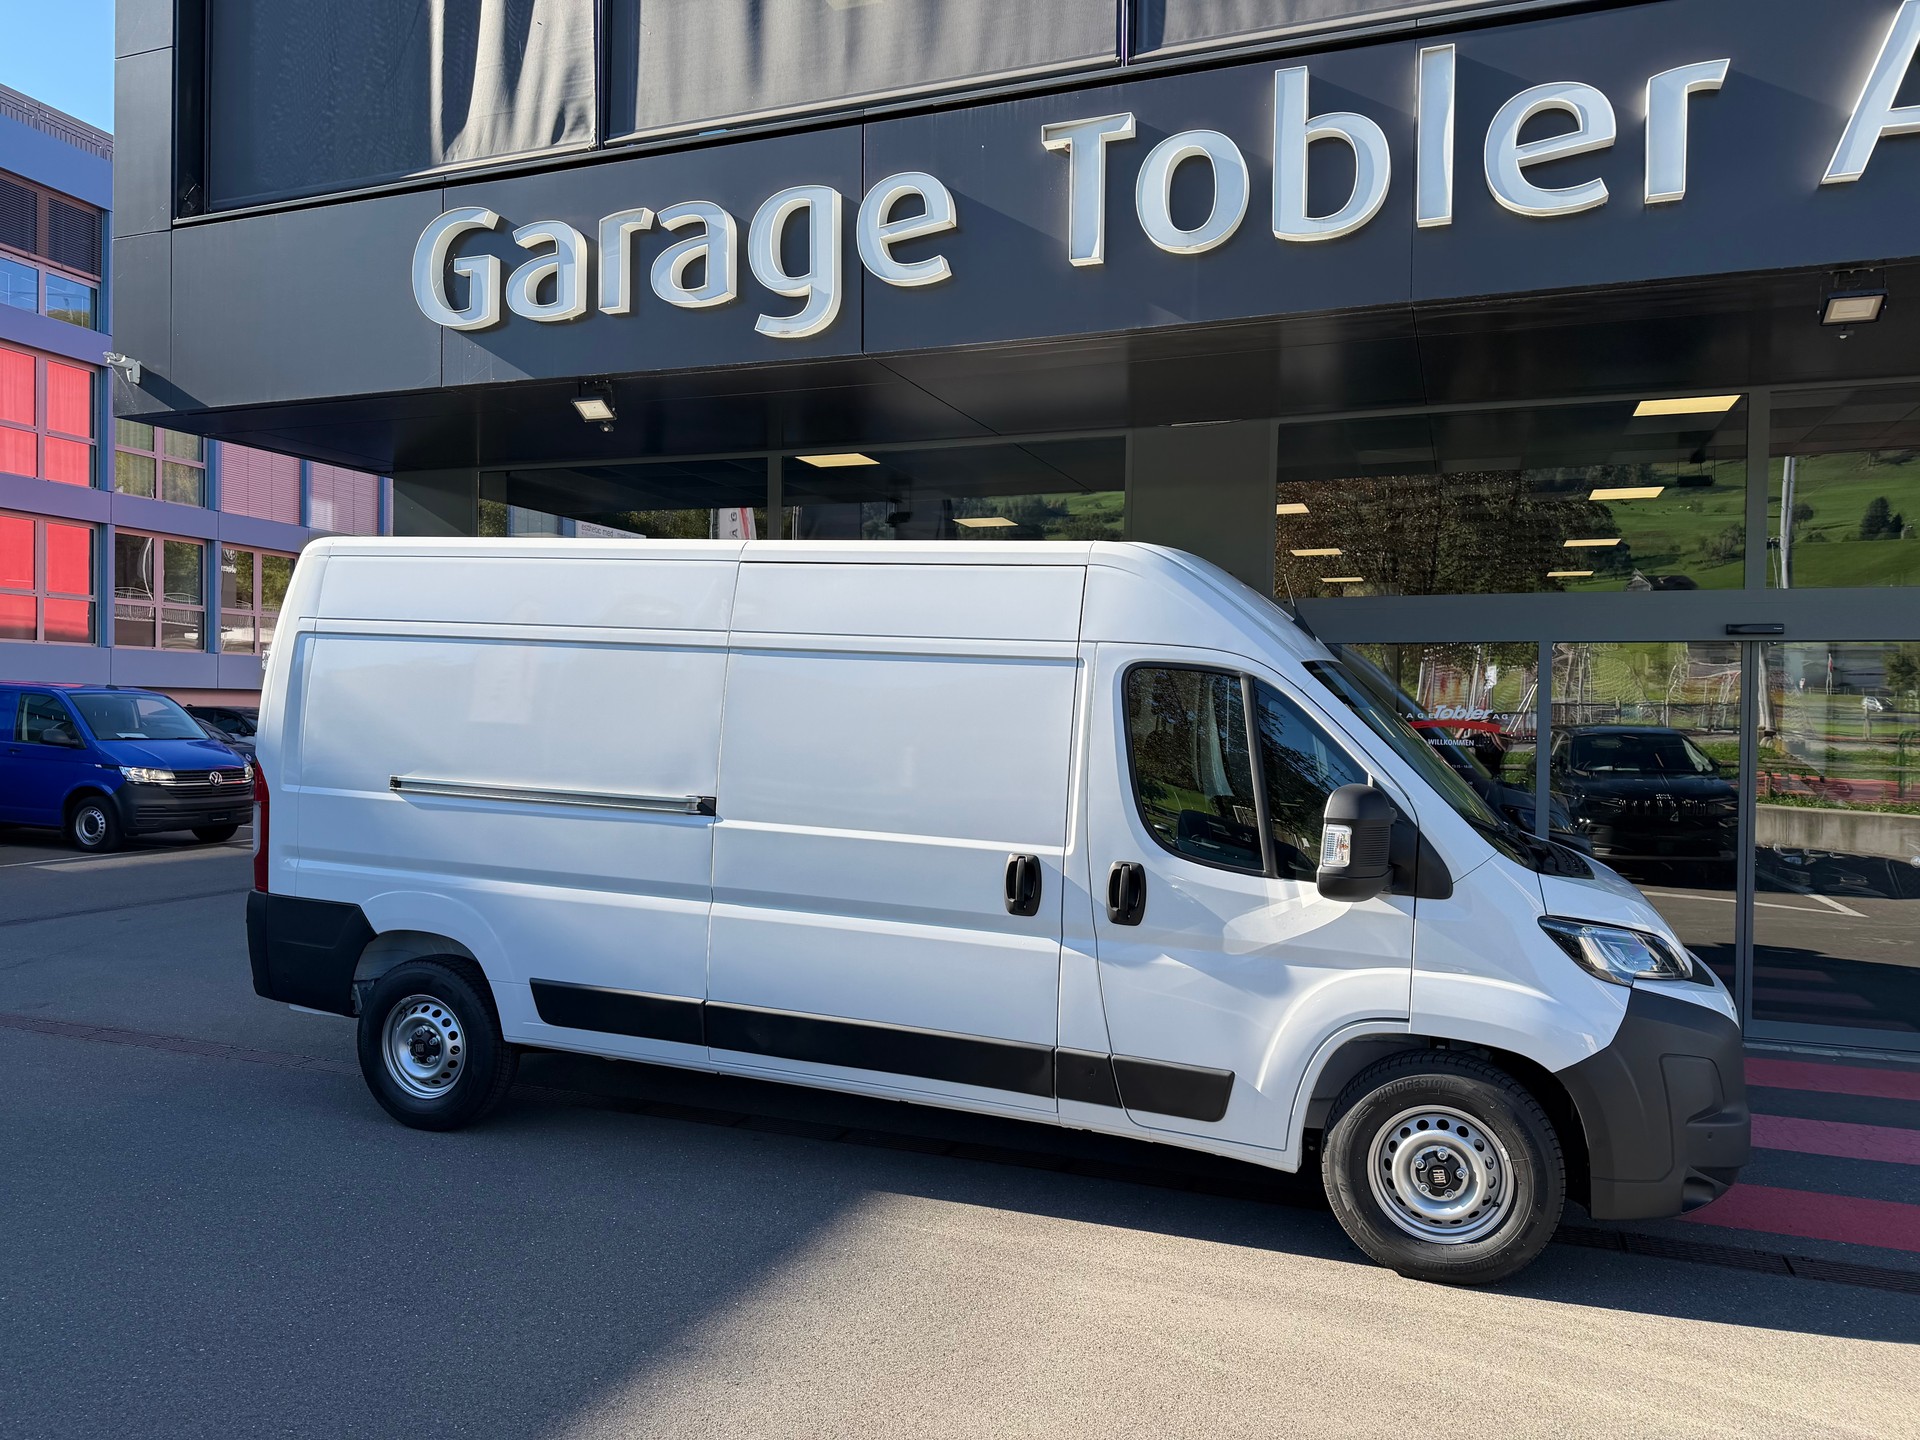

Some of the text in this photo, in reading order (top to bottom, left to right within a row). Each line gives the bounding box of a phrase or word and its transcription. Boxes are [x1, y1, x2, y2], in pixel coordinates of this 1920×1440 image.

[411, 172, 958, 339] Garage
[1041, 43, 1731, 267] Tobler
[1434, 704, 1494, 721] Tobler
[1428, 738, 1475, 747] WILLKOMMEN
[1432, 1169, 1447, 1184] FIAT
